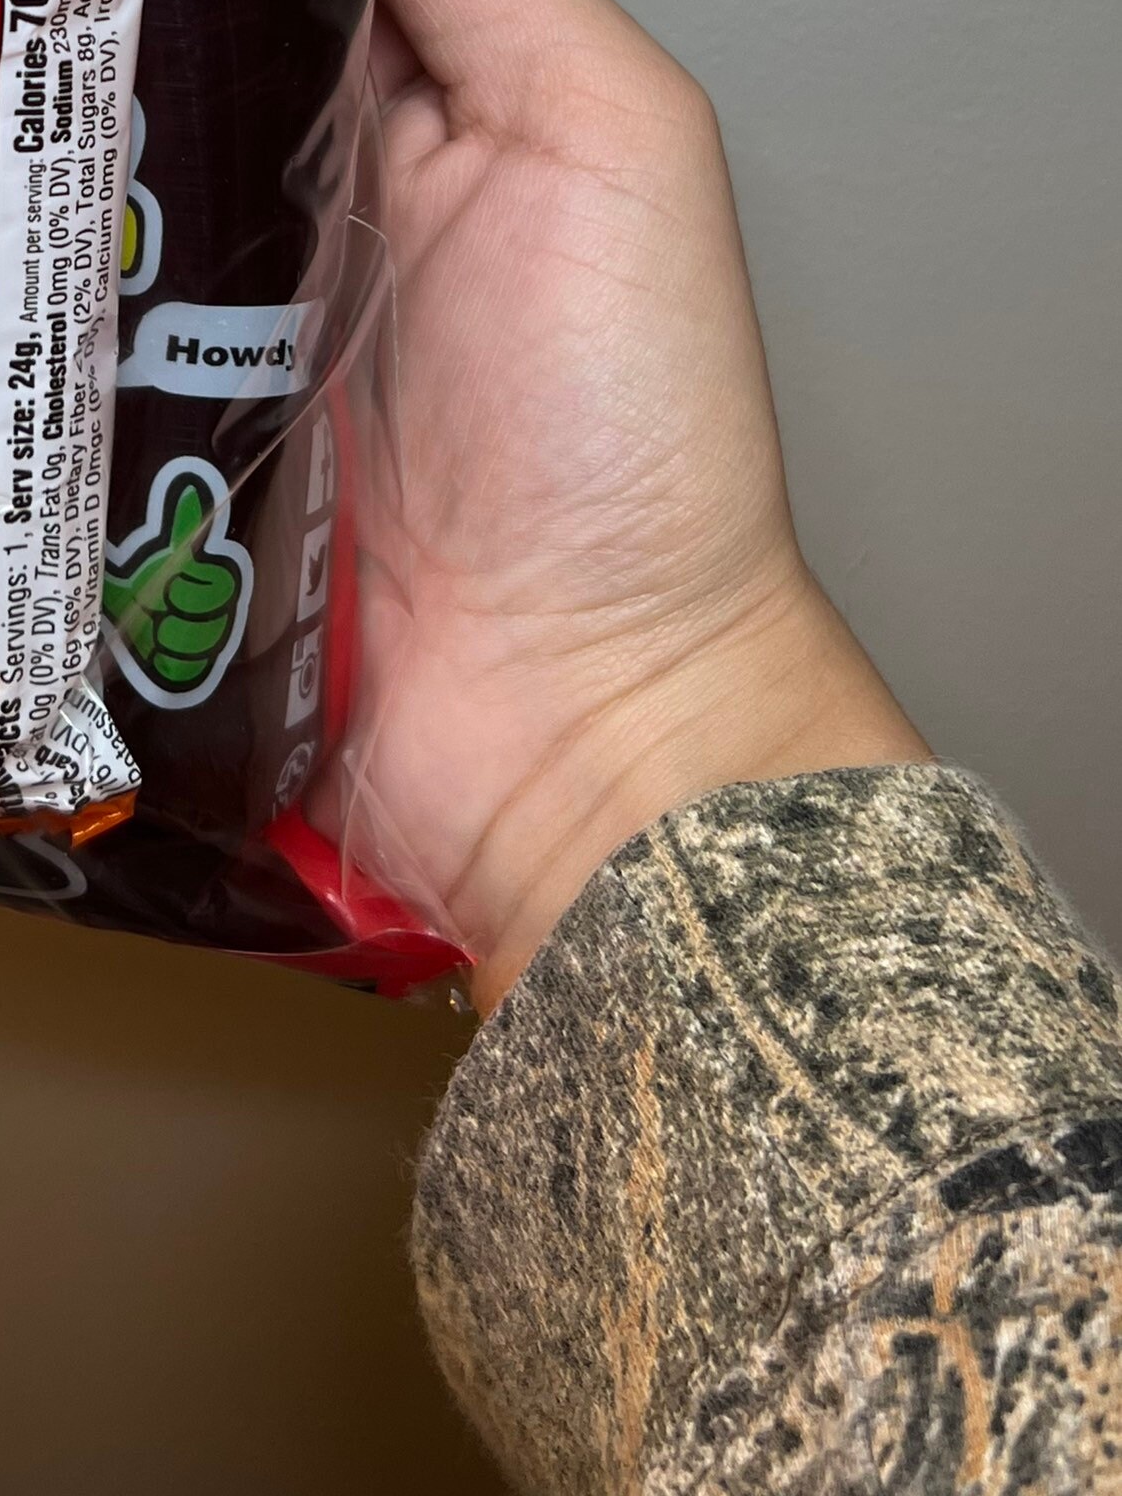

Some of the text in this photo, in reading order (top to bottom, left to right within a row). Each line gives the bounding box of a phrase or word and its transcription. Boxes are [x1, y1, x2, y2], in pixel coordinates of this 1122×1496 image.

[76, 26, 95, 62] 8g,
[98, 30, 120, 82] DV),
[13, 37, 47, 153] Calories
[50, 60, 73, 143] Sodium
[78, 68, 99, 150] Sugars
[99, 92, 118, 138] (0%
[24, 158, 46, 223] serving:
[50, 150, 75, 197] DV),
[76, 157, 96, 214] Total
[98, 148, 118, 202] 0mg
[26, 229, 44, 254] per
[48, 206, 73, 249] (0%
[74, 220, 96, 270] DV),
[94, 208, 113, 302] Calcium
[19, 259, 40, 323] Amount
[47, 257, 72, 305] 0mg
[73, 278, 93, 324] (2%
[8, 332, 42, 389] 24g,
[42, 312, 67, 440] Cholesterol
[7, 399, 35, 460] size:
[70, 382, 86, 436] Fiber
[42, 446, 66, 479] 0g,
[65, 444, 88, 518] Dietary
[3, 468, 33, 524] Serv
[40, 487, 61, 517] Fat
[85, 494, 100, 512] D
[3, 532, 33, 556] 1,
[35, 523, 61, 580] Trans
[65, 528, 83, 578] DV),
[84, 516, 100, 608] Vitamin
[0, 565, 31, 683] Servings:
[31, 590, 64, 635] DV),
[64, 586, 82, 633] (6%
[29, 644, 60, 685] (0%
[63, 638, 84, 682] 16g
[29, 694, 57, 721] 0g
